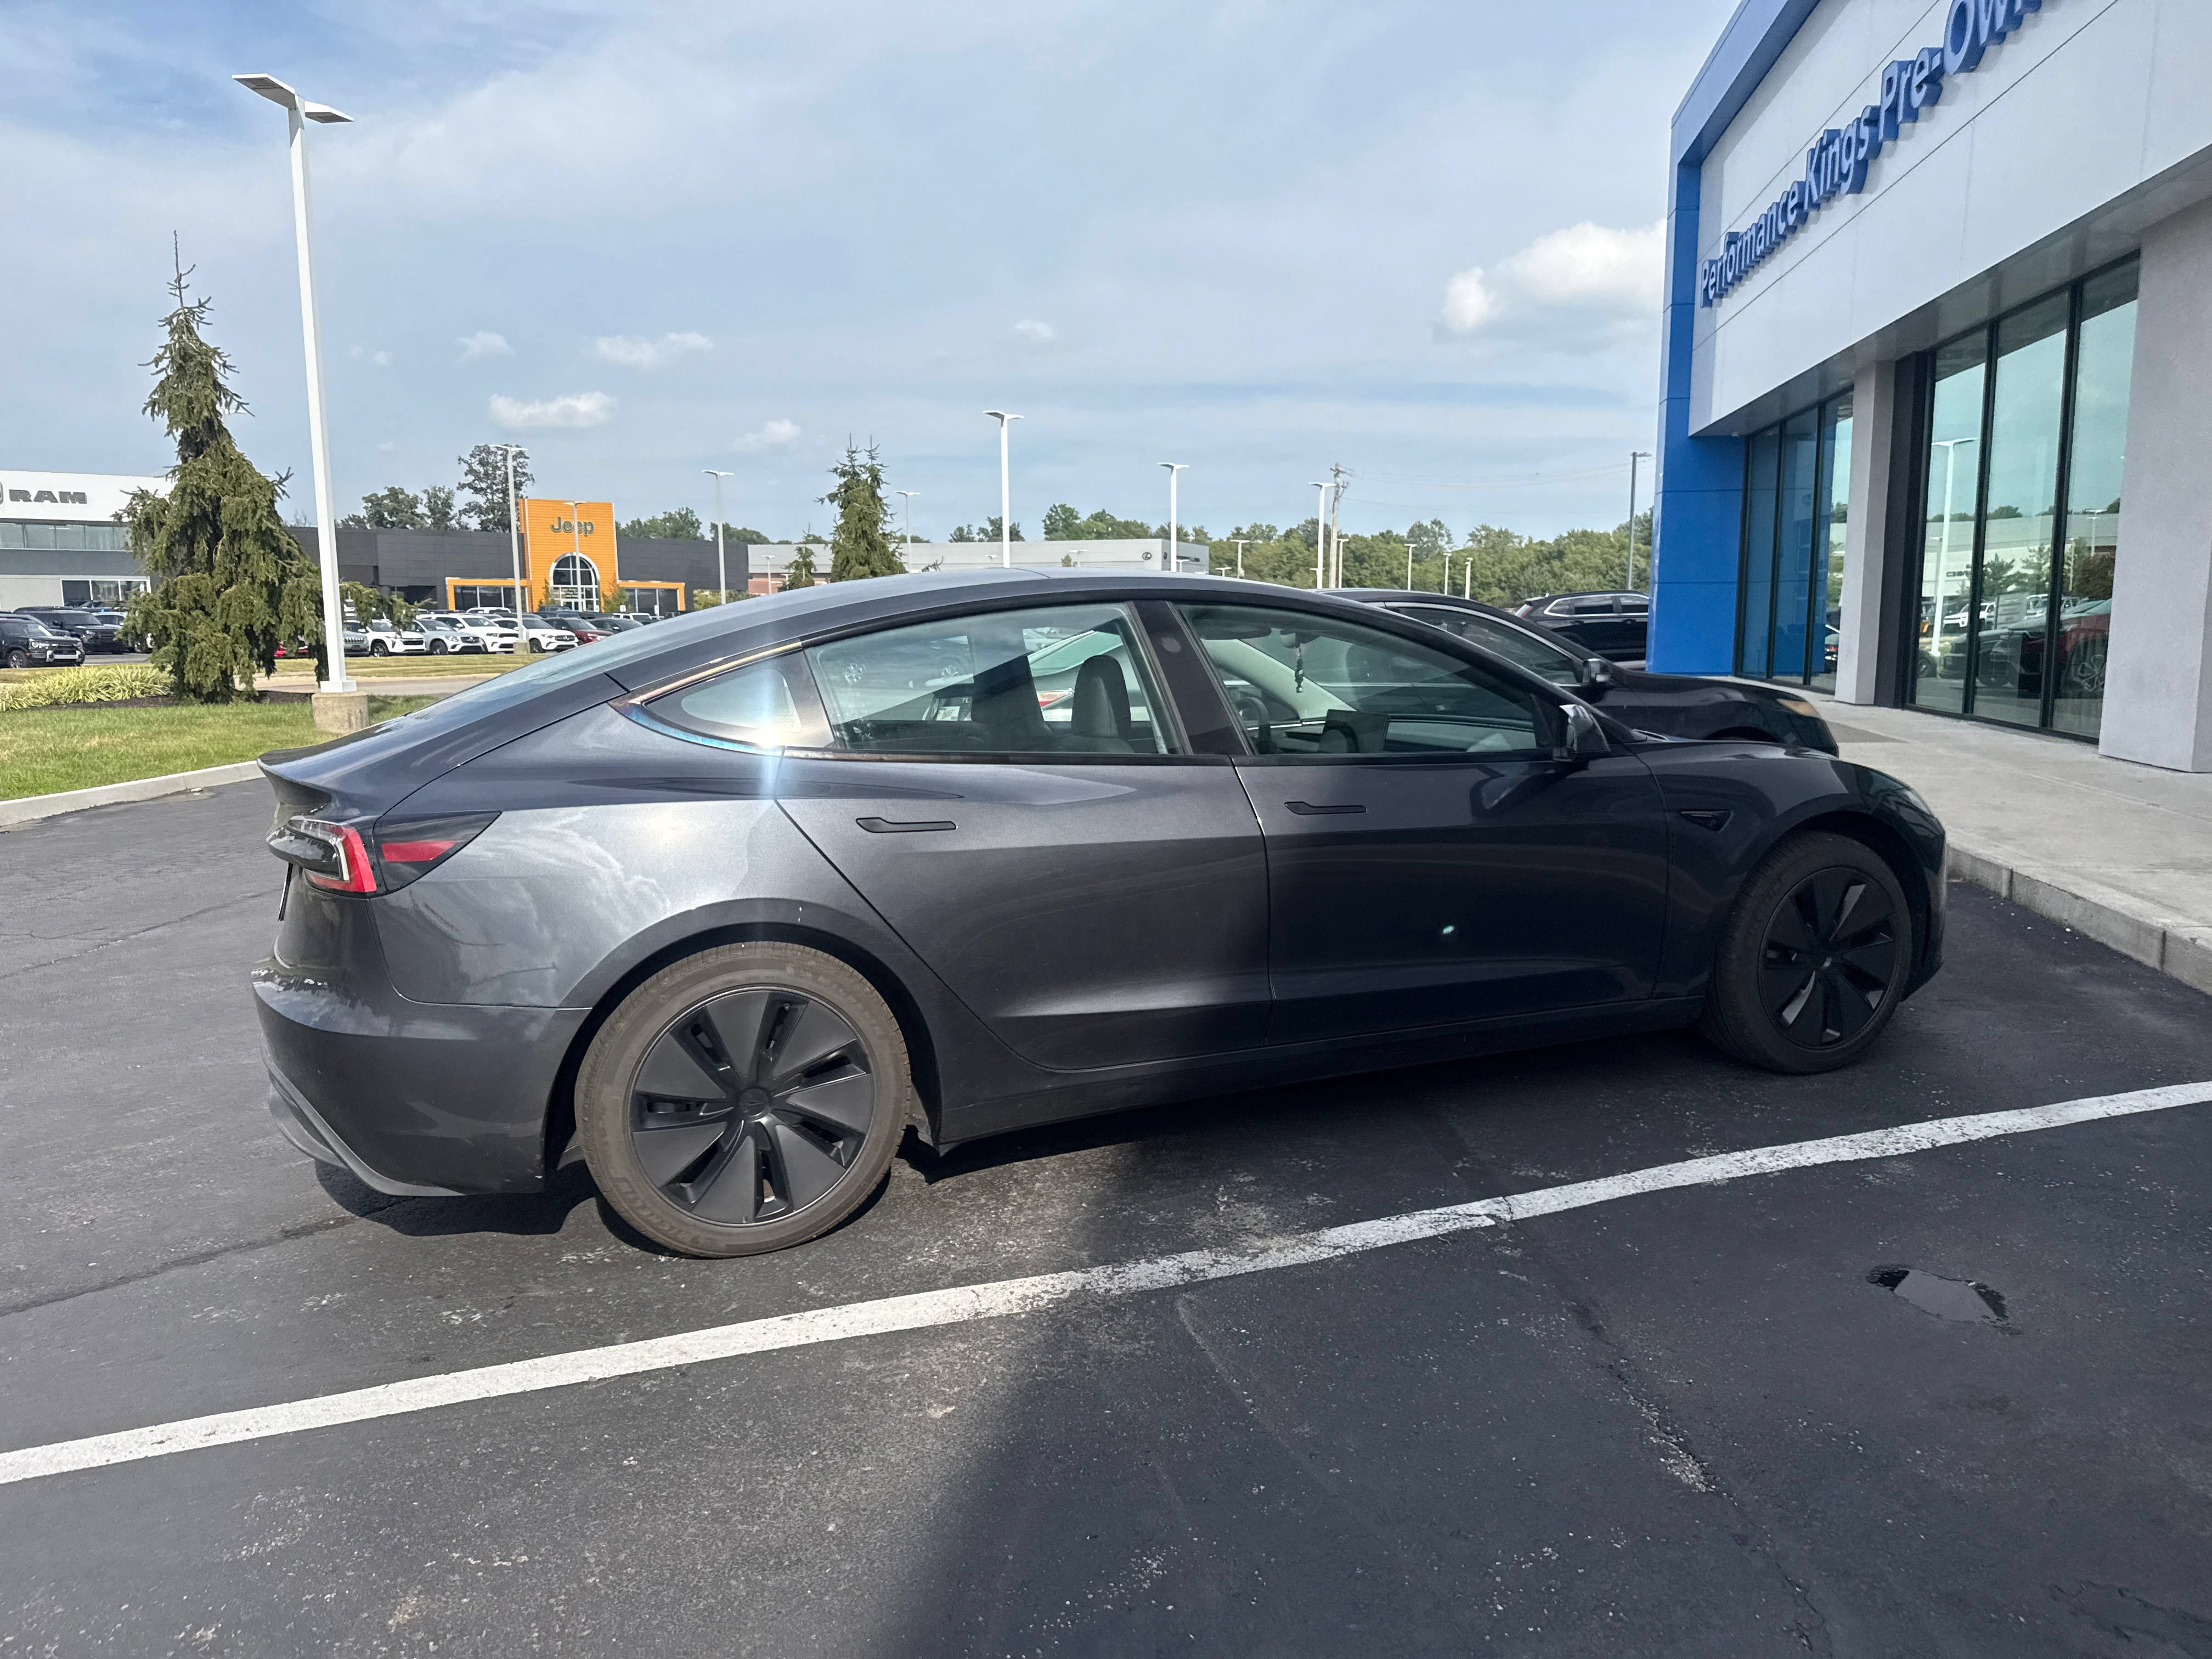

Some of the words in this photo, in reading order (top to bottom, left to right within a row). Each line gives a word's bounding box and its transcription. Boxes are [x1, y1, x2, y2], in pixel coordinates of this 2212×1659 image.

[1700, 181, 1805, 308] Performance
[1803, 105, 1876, 211] Kings
[1878, 0, 2034, 142] Pre-Ow
[8, 489, 88, 504] RAM
[550, 516, 595, 537] Jeep
